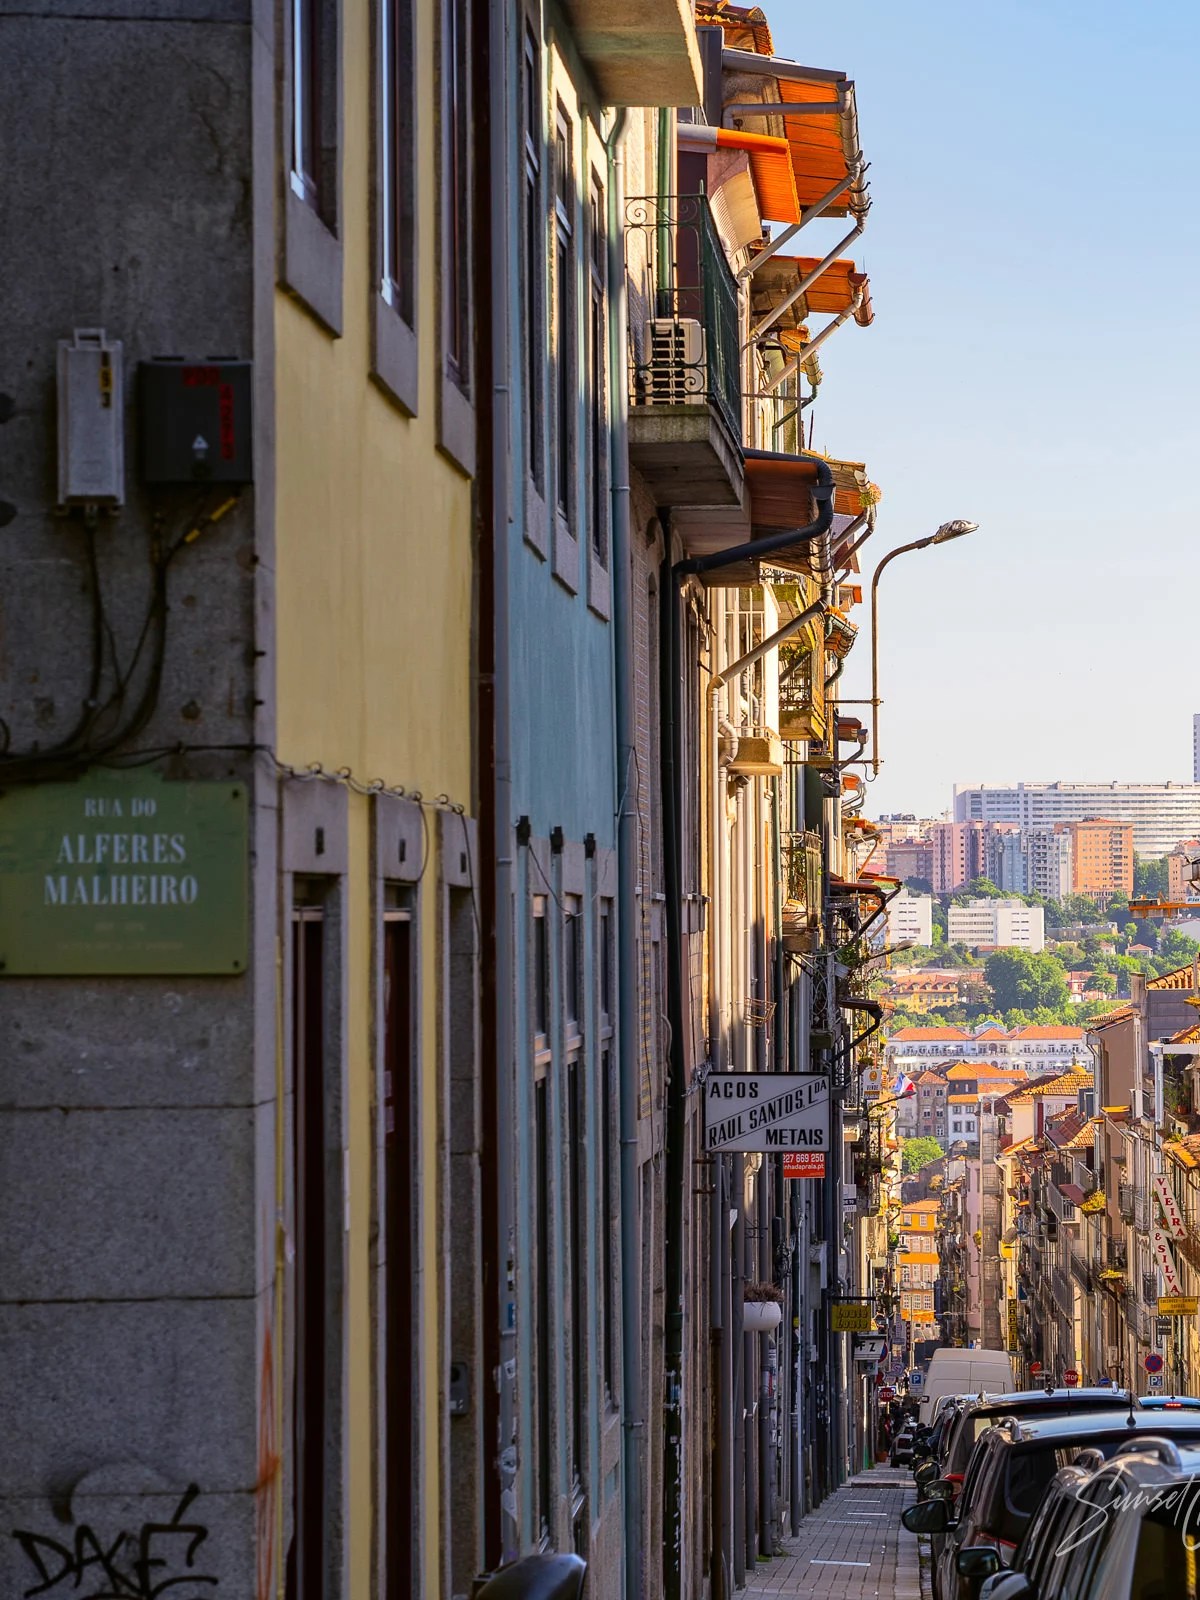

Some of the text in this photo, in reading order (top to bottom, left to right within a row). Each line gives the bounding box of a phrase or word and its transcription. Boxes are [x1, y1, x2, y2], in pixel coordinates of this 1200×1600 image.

[84, 797, 157, 817] RUA DO
[57, 833, 187, 864] ALFERES
[44, 874, 199, 905] MALHEIRO
[709, 1115, 745, 1148] RAUL
[765, 1128, 823, 1145] METAIS
[796, 1153, 809, 1163] 669
[811, 1153, 825, 1163] 250
[1157, 1178, 1185, 1237] VIEIRA
[1157, 1244, 1180, 1293] SILVA
